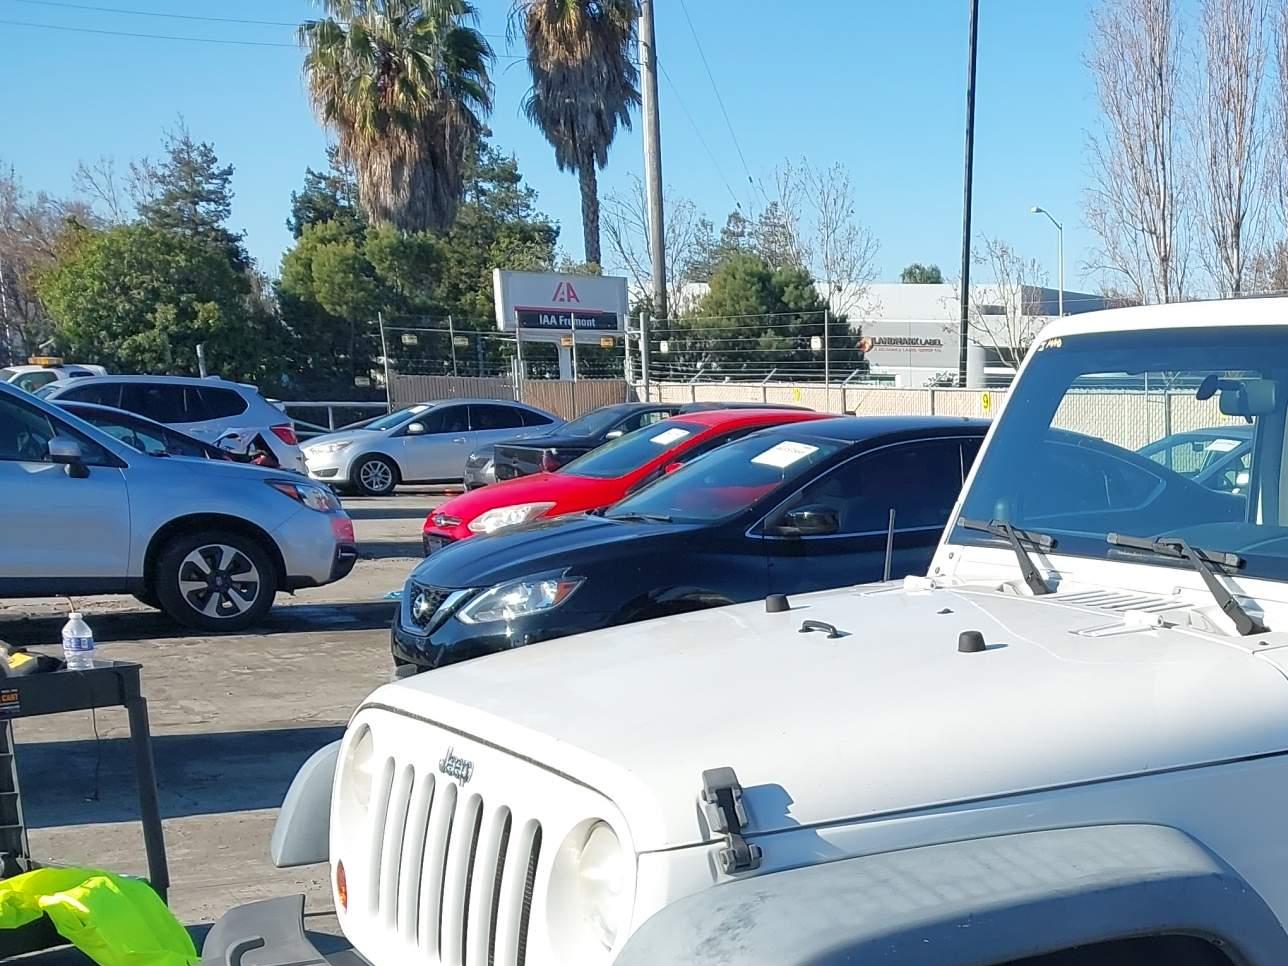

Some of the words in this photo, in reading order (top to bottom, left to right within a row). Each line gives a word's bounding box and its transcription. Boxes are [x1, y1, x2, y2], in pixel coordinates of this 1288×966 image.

[539, 314, 557, 326] IAA
[874, 337, 919, 345] LANDMARK
[919, 338, 942, 346] LABEL
[439, 745, 474, 787] Jeep
